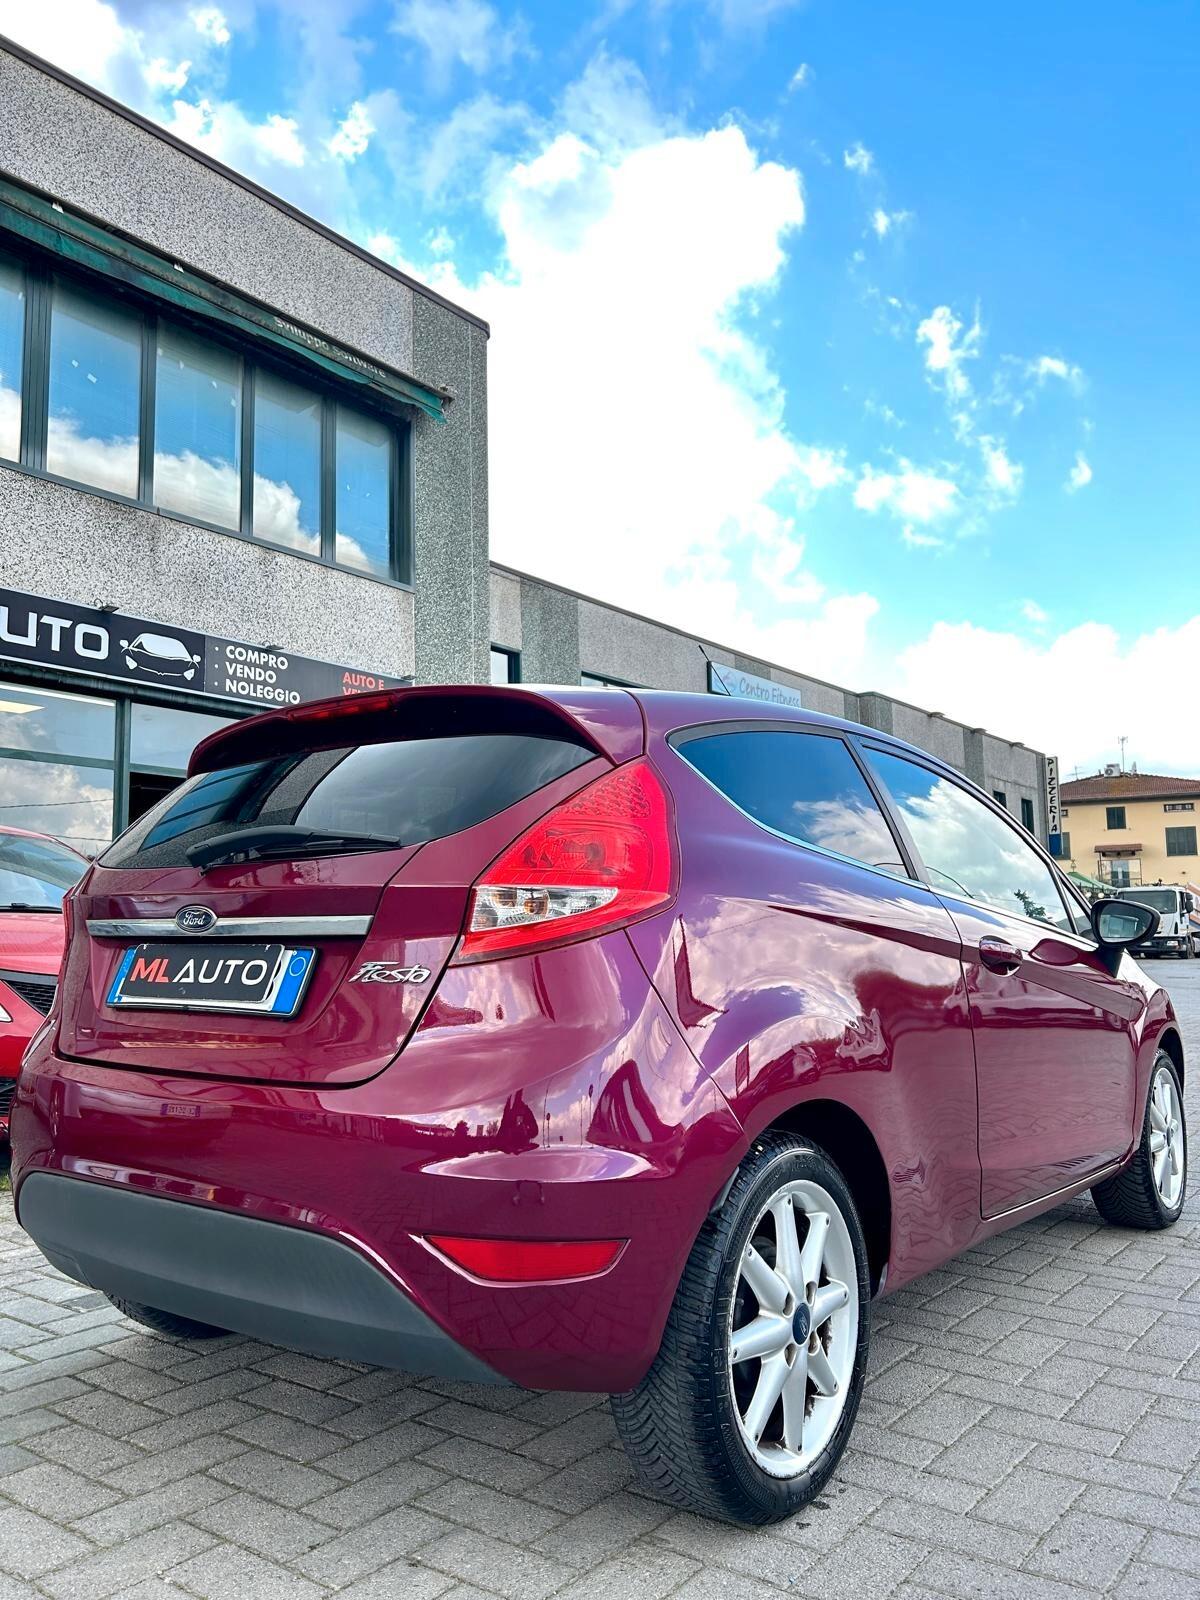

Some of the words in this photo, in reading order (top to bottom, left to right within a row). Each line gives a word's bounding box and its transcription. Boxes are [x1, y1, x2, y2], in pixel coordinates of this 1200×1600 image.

[273, 316, 330, 351] Sviluppo
[0, 605, 110, 661] UTO
[225, 645, 289, 671] COMPRO
[225, 662, 277, 685] VENDO
[342, 671, 376, 689] AUTO
[378, 679, 385, 691] E
[225, 679, 301, 705] NOLEGGIO
[740, 678, 769, 700] Centro
[771, 687, 800, 707] Fitness
[1047, 758, 1058, 832] PIZZERIA
[182, 910, 206, 926] Ford
[130, 957, 170, 984] ML
[172, 958, 268, 986] AUTO
[348, 960, 431, 984] Fiesta
